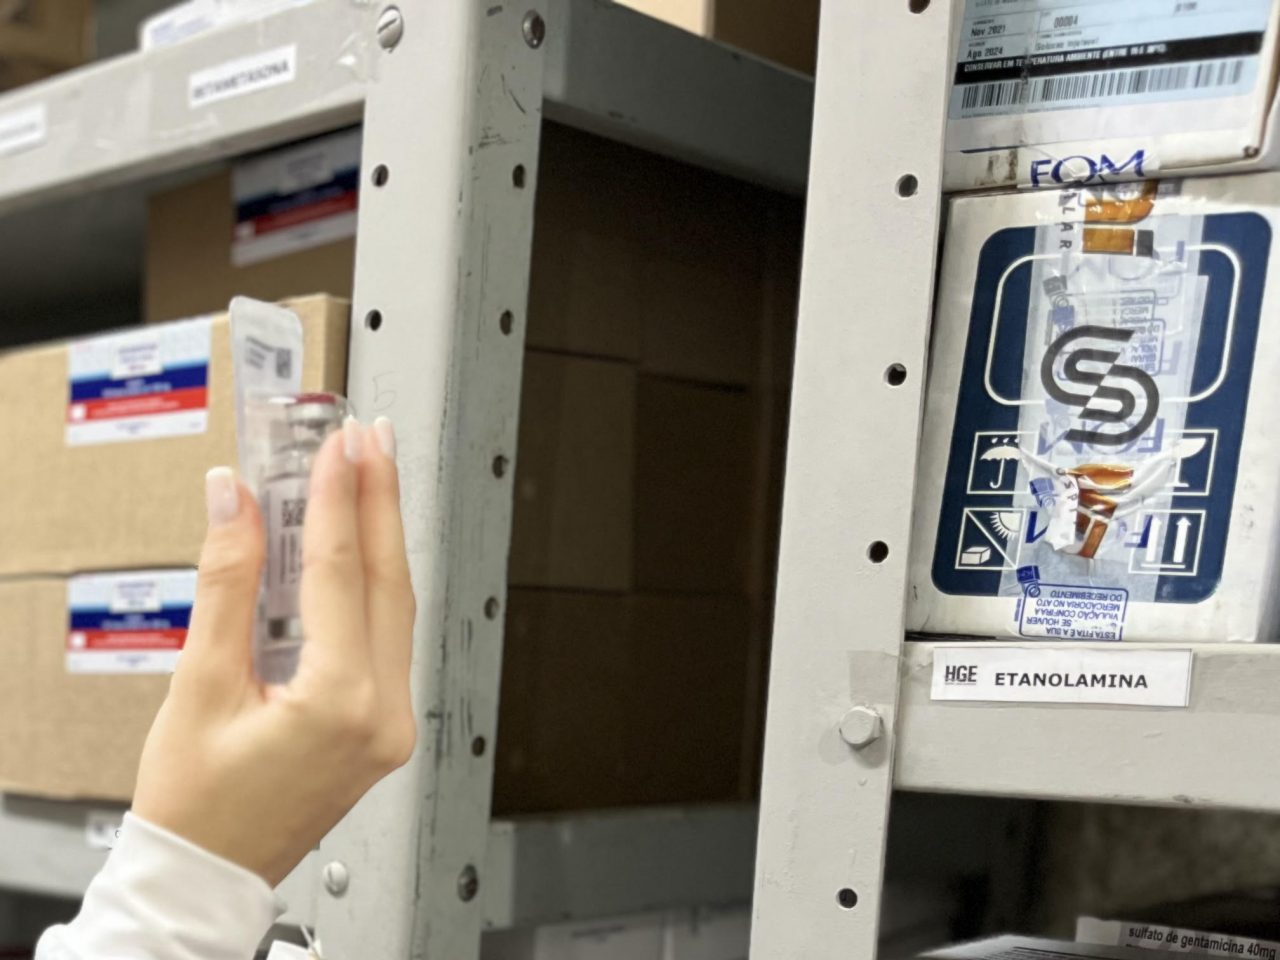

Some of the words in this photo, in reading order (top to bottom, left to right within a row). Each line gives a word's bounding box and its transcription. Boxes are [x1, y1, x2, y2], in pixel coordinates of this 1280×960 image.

[945, 665, 977, 684] HGE
[994, 672, 1148, 689] ETANOLAMINA
[1128, 926, 1163, 941] sulfato
[1166, 931, 1178, 943] de
[1181, 934, 1244, 954] gentamicina
[1247, 942, 1276, 960] 40mg
